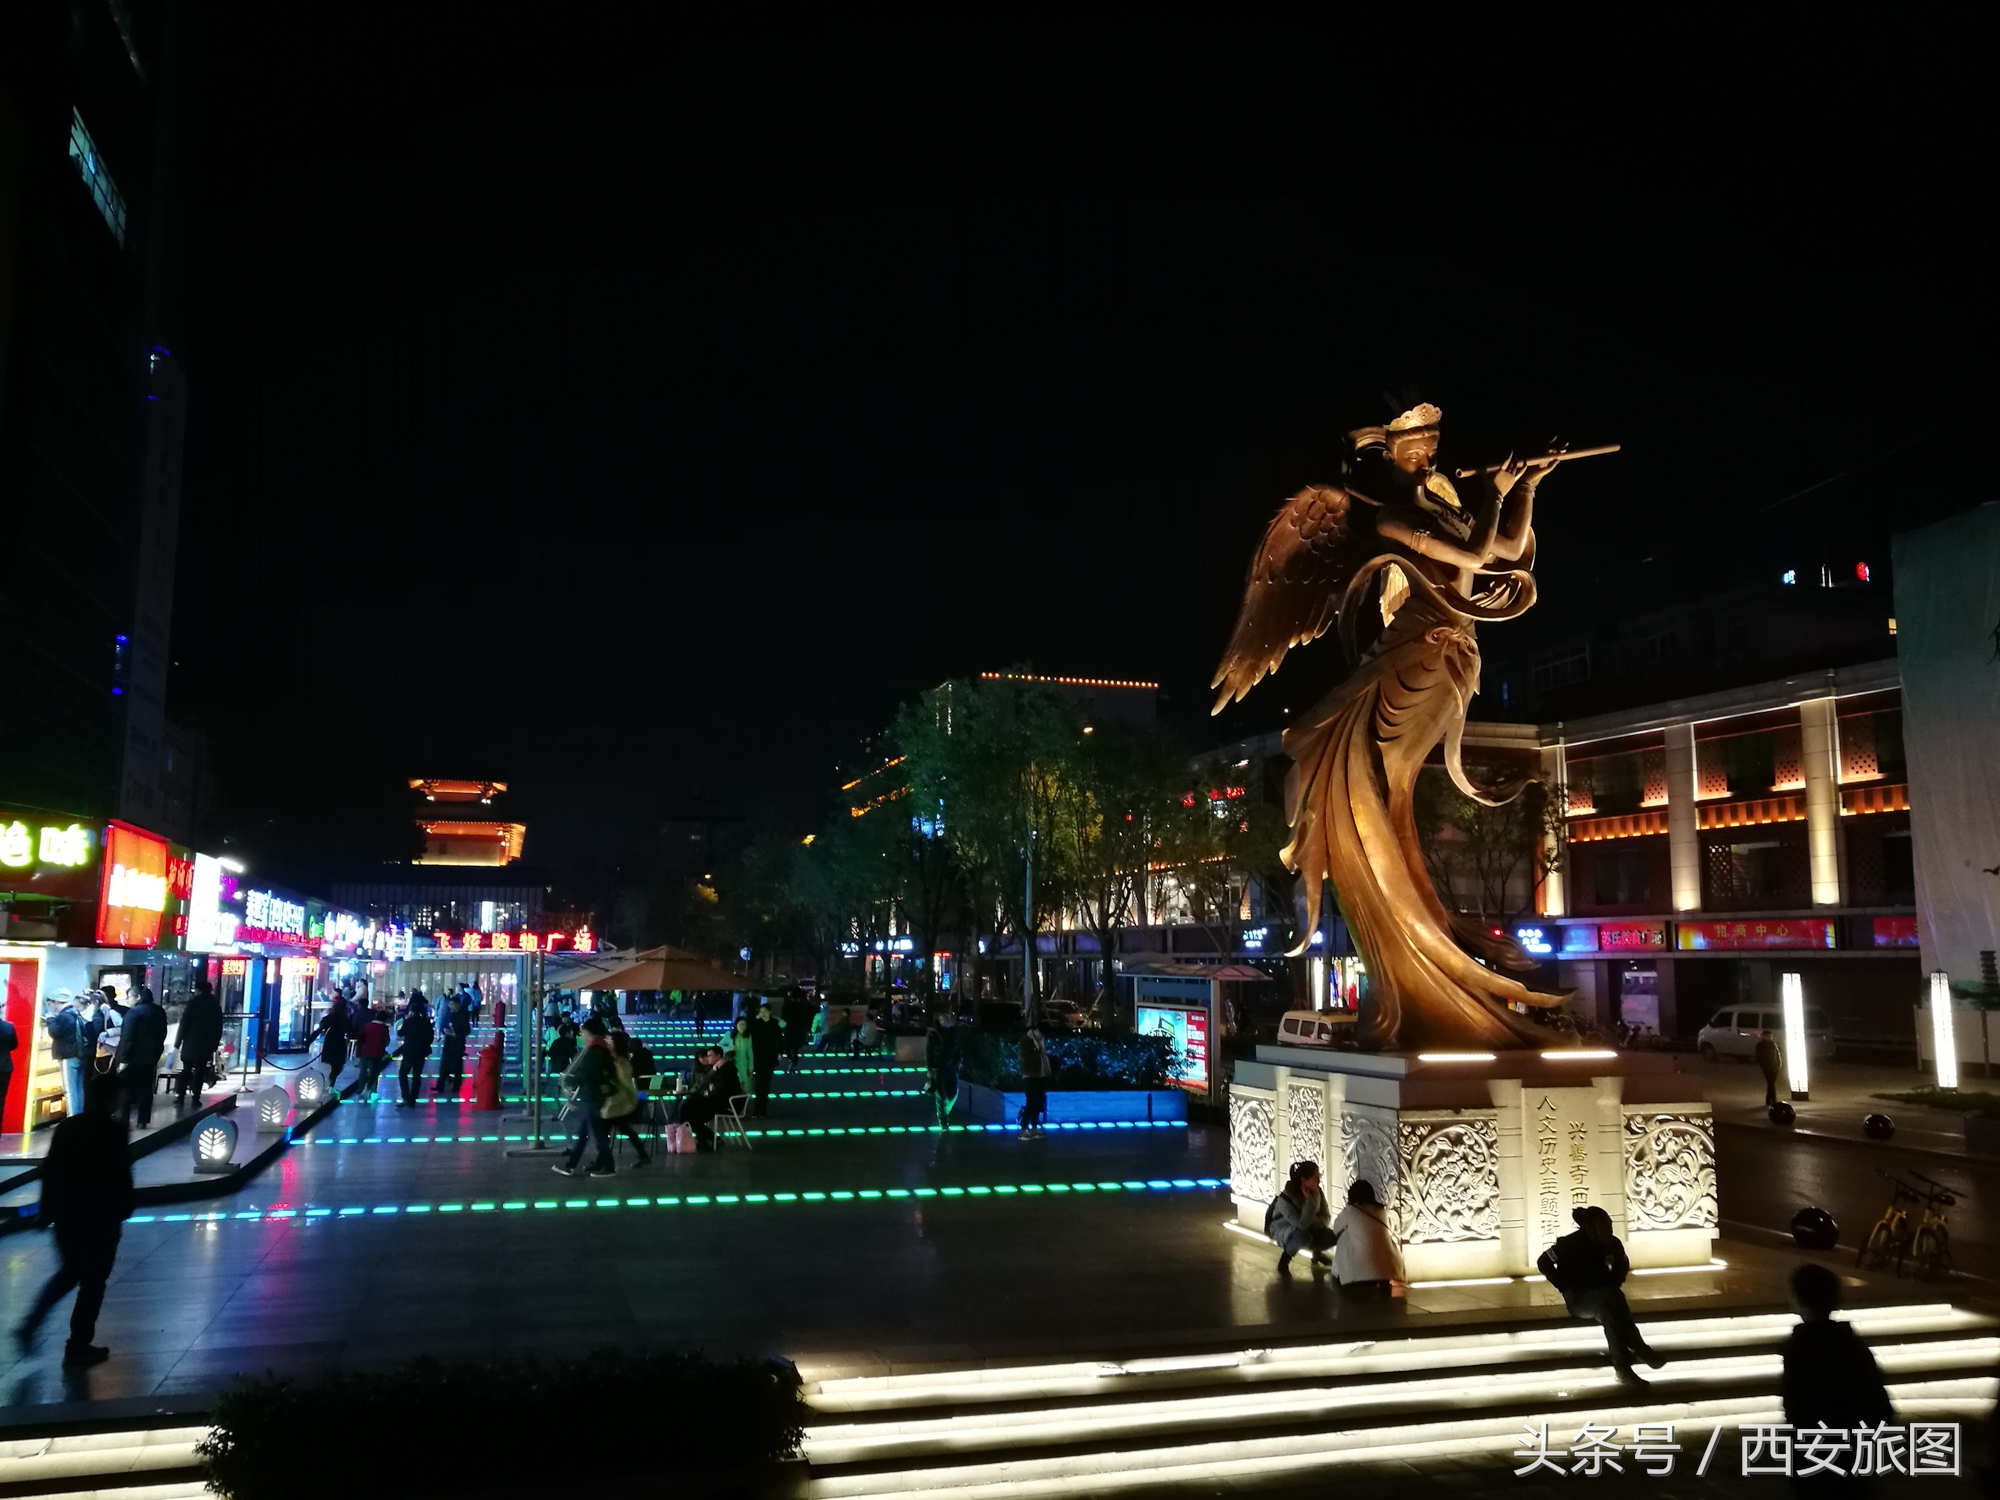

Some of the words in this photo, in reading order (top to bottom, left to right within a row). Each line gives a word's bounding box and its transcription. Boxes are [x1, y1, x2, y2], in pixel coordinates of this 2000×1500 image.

[432, 930, 594, 953] 飞炫购物广场
[1716, 923, 1789, 937] 招商中心
[1567, 1120, 1591, 1230] 兴善寺西
